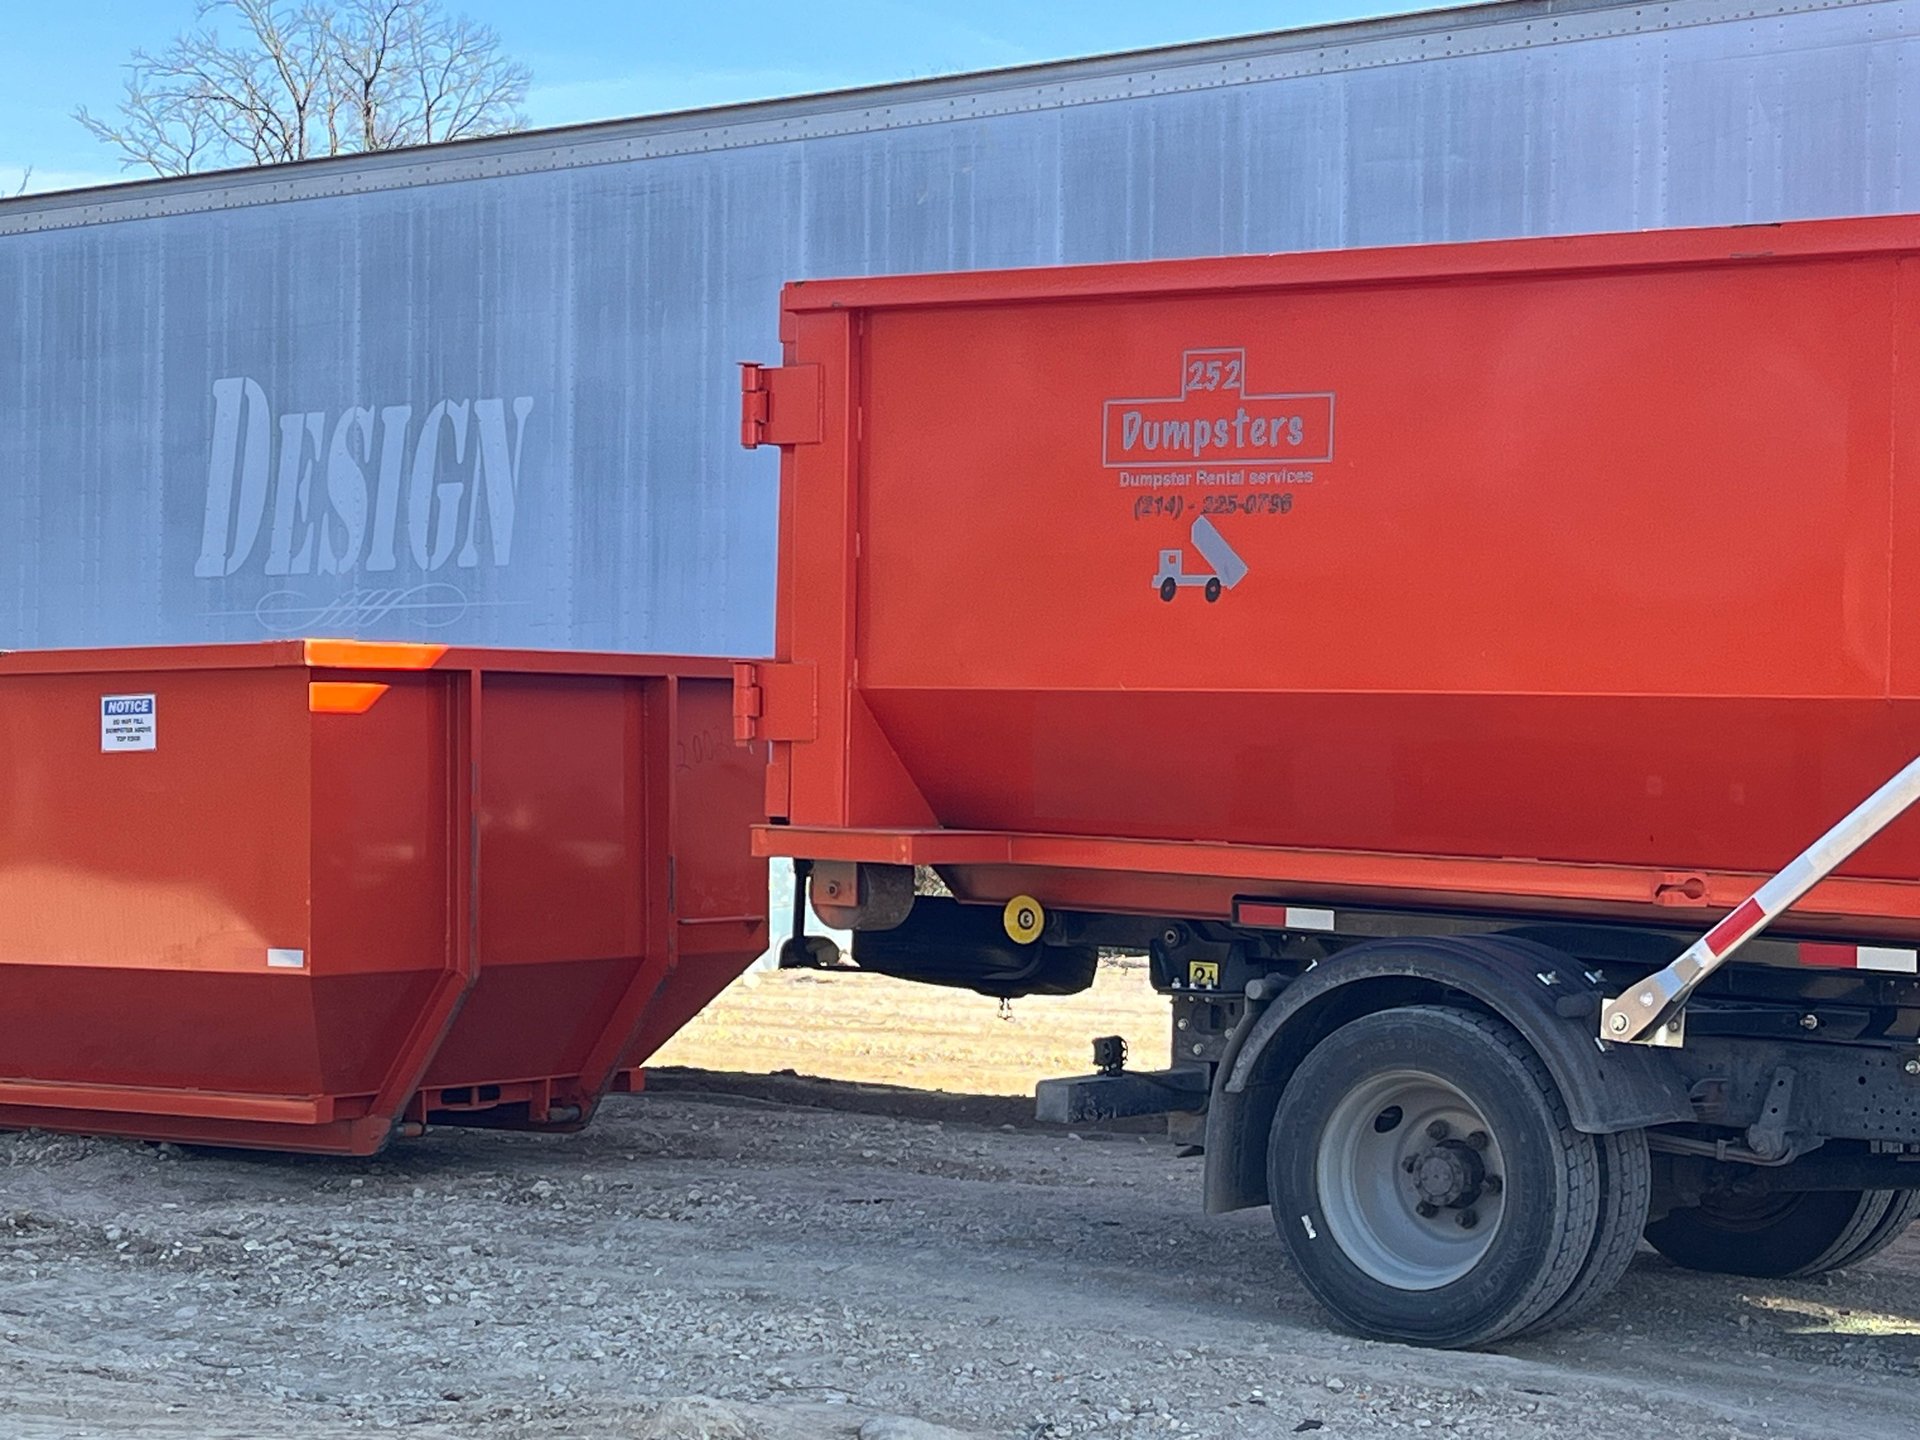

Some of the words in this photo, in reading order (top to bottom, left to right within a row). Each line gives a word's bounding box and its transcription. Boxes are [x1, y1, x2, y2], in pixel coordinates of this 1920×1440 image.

[1185, 359, 1241, 391] 252
[1122, 407, 1304, 457] Dumpsters
[1119, 472, 1192, 490] Dumpster
[1196, 470, 1245, 486] Rental
[1249, 468, 1314, 485] services
[1134, 495, 1184, 521] (214)
[107, 699, 150, 714] NOTICE
